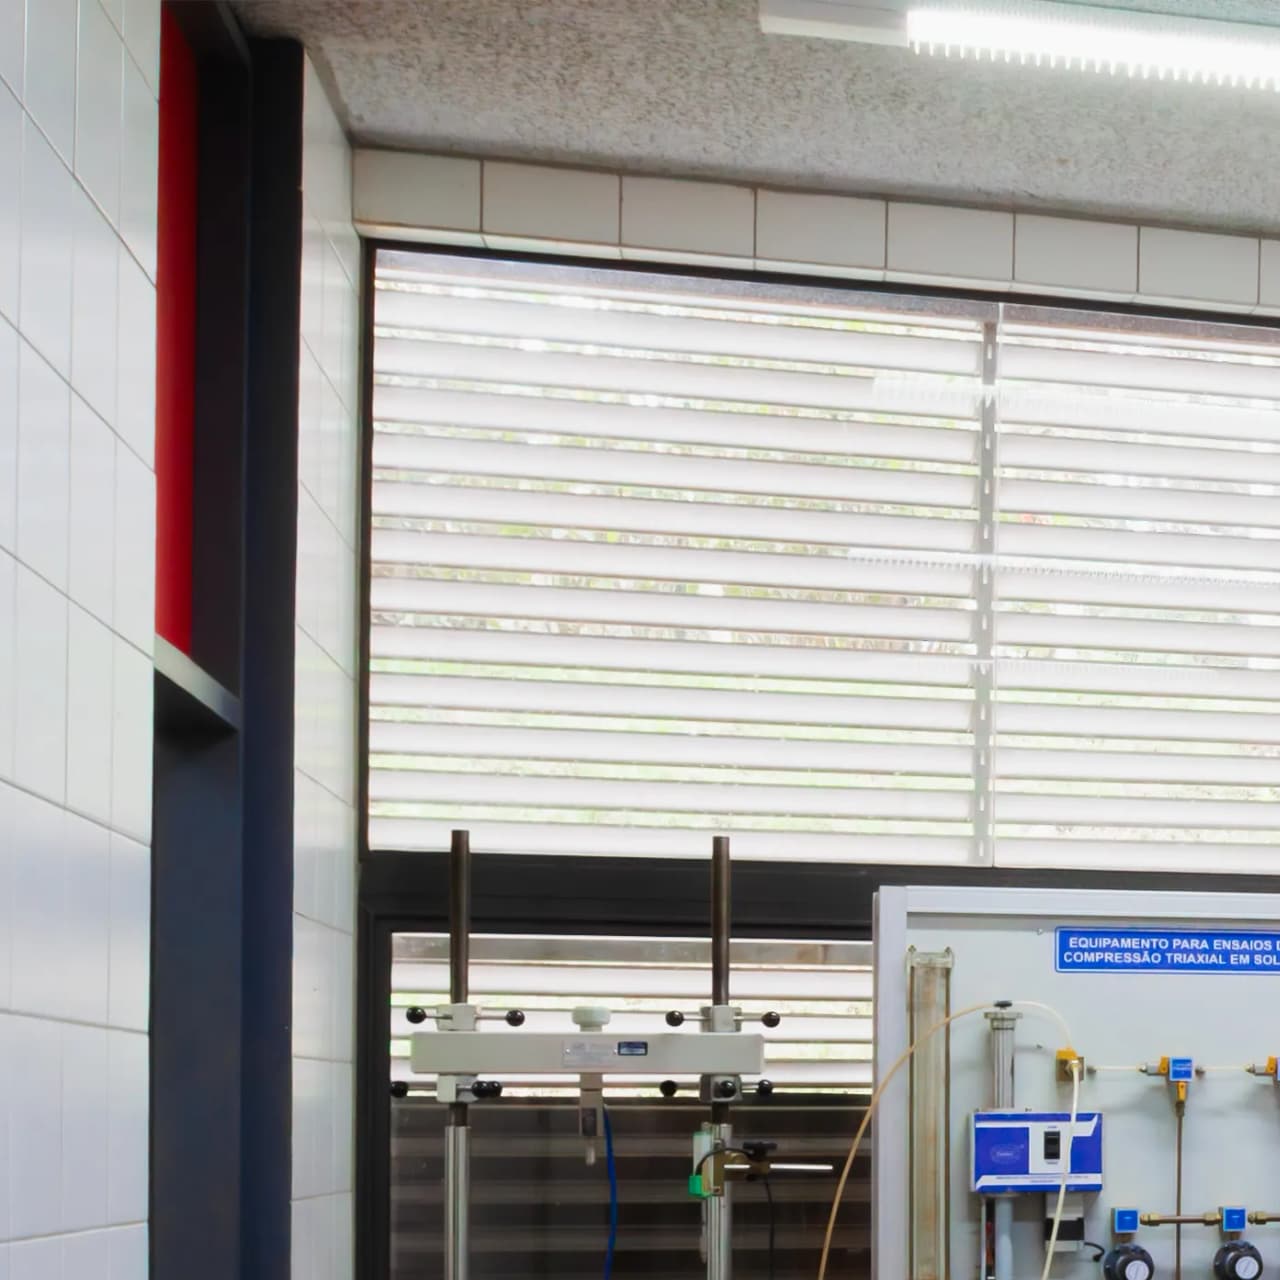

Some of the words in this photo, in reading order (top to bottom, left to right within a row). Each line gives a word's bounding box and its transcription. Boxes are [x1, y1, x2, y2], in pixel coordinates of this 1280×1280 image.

[1069, 937, 1169, 951] EQUIPAMENTO
[1173, 938, 1208, 951] PARA
[1213, 939, 1273, 951] ENSAIOS
[1063, 950, 1162, 964] COMPRESSÃO
[1166, 953, 1226, 965] TRIAXIAL
[1230, 954, 1250, 965] EM
